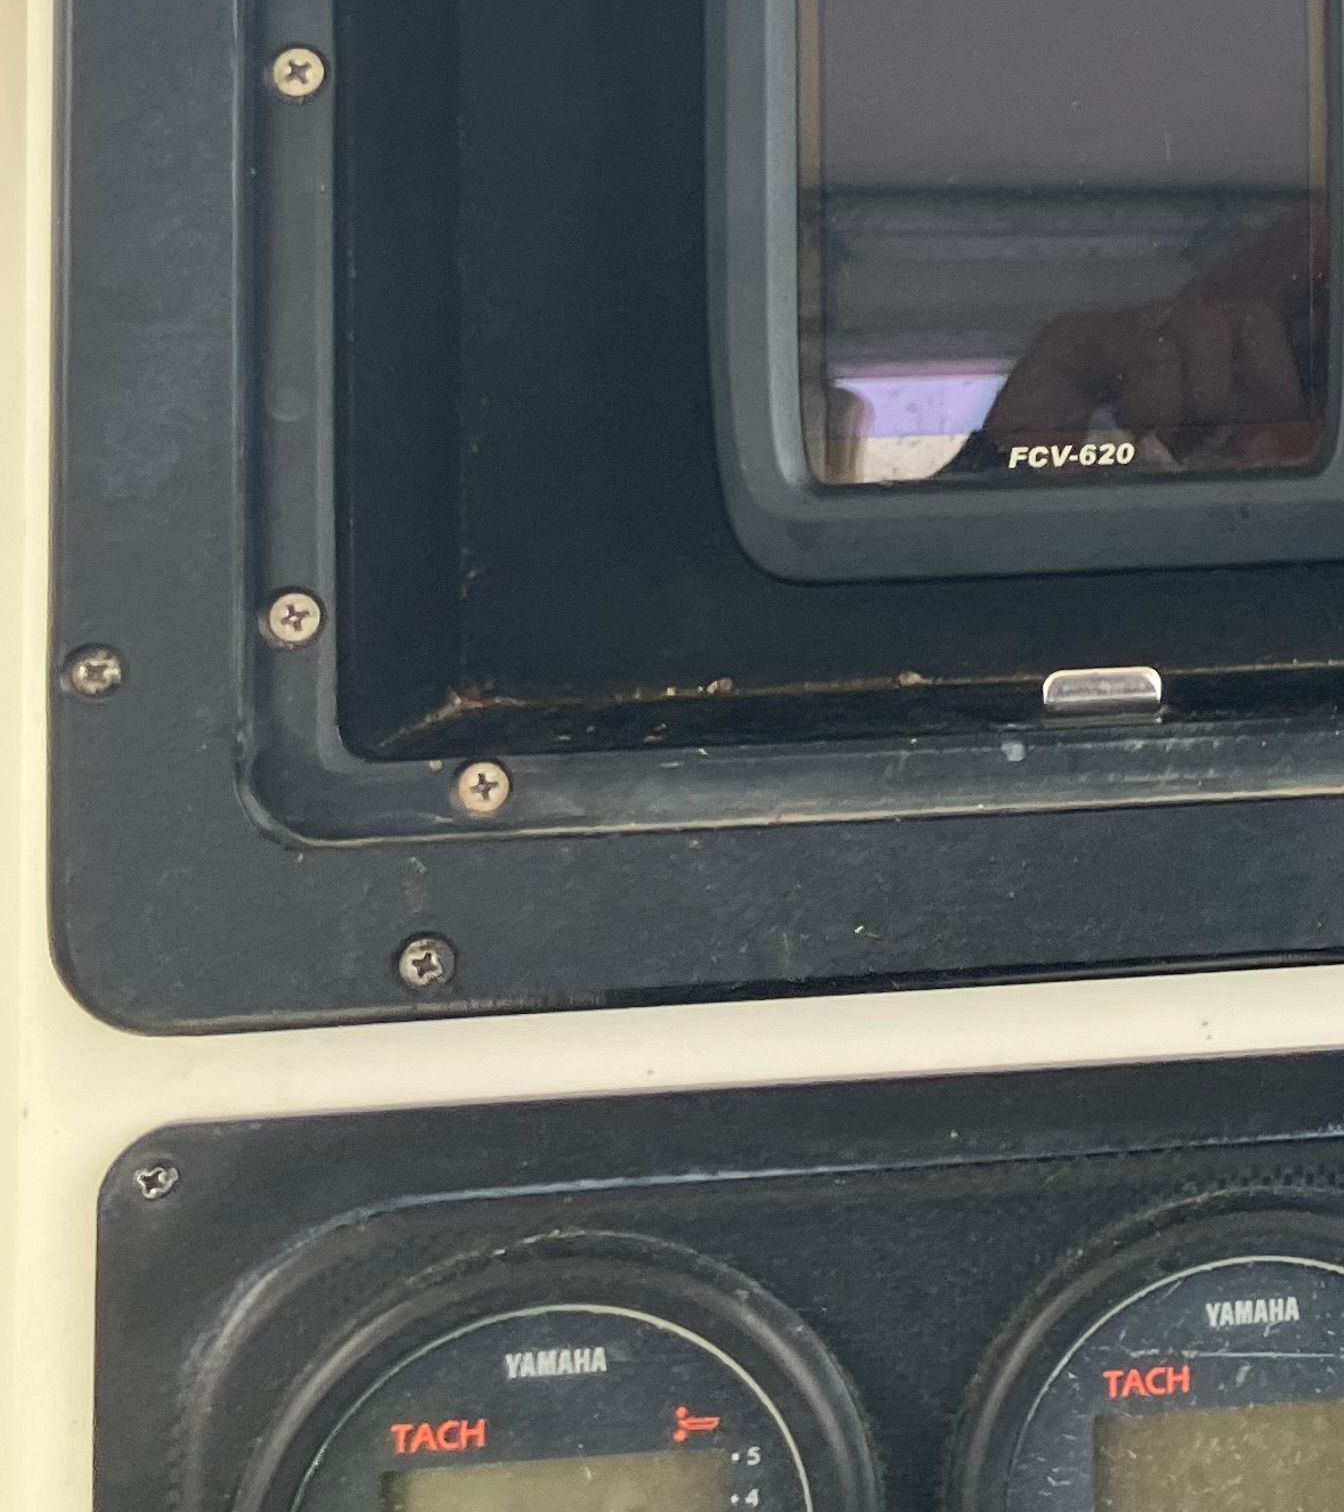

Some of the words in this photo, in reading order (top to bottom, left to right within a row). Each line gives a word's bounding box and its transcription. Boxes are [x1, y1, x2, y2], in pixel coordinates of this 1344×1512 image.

[1008, 442, 1136, 469] FCV-620
[1205, 1296, 1300, 1328] YAMAHA
[505, 1346, 607, 1380] YAMAHA
[1103, 1365, 1192, 1399] TACH
[391, 1418, 488, 1455] TACH
[746, 1446, 761, 1466] 5
[745, 1488, 760, 1508] 4
